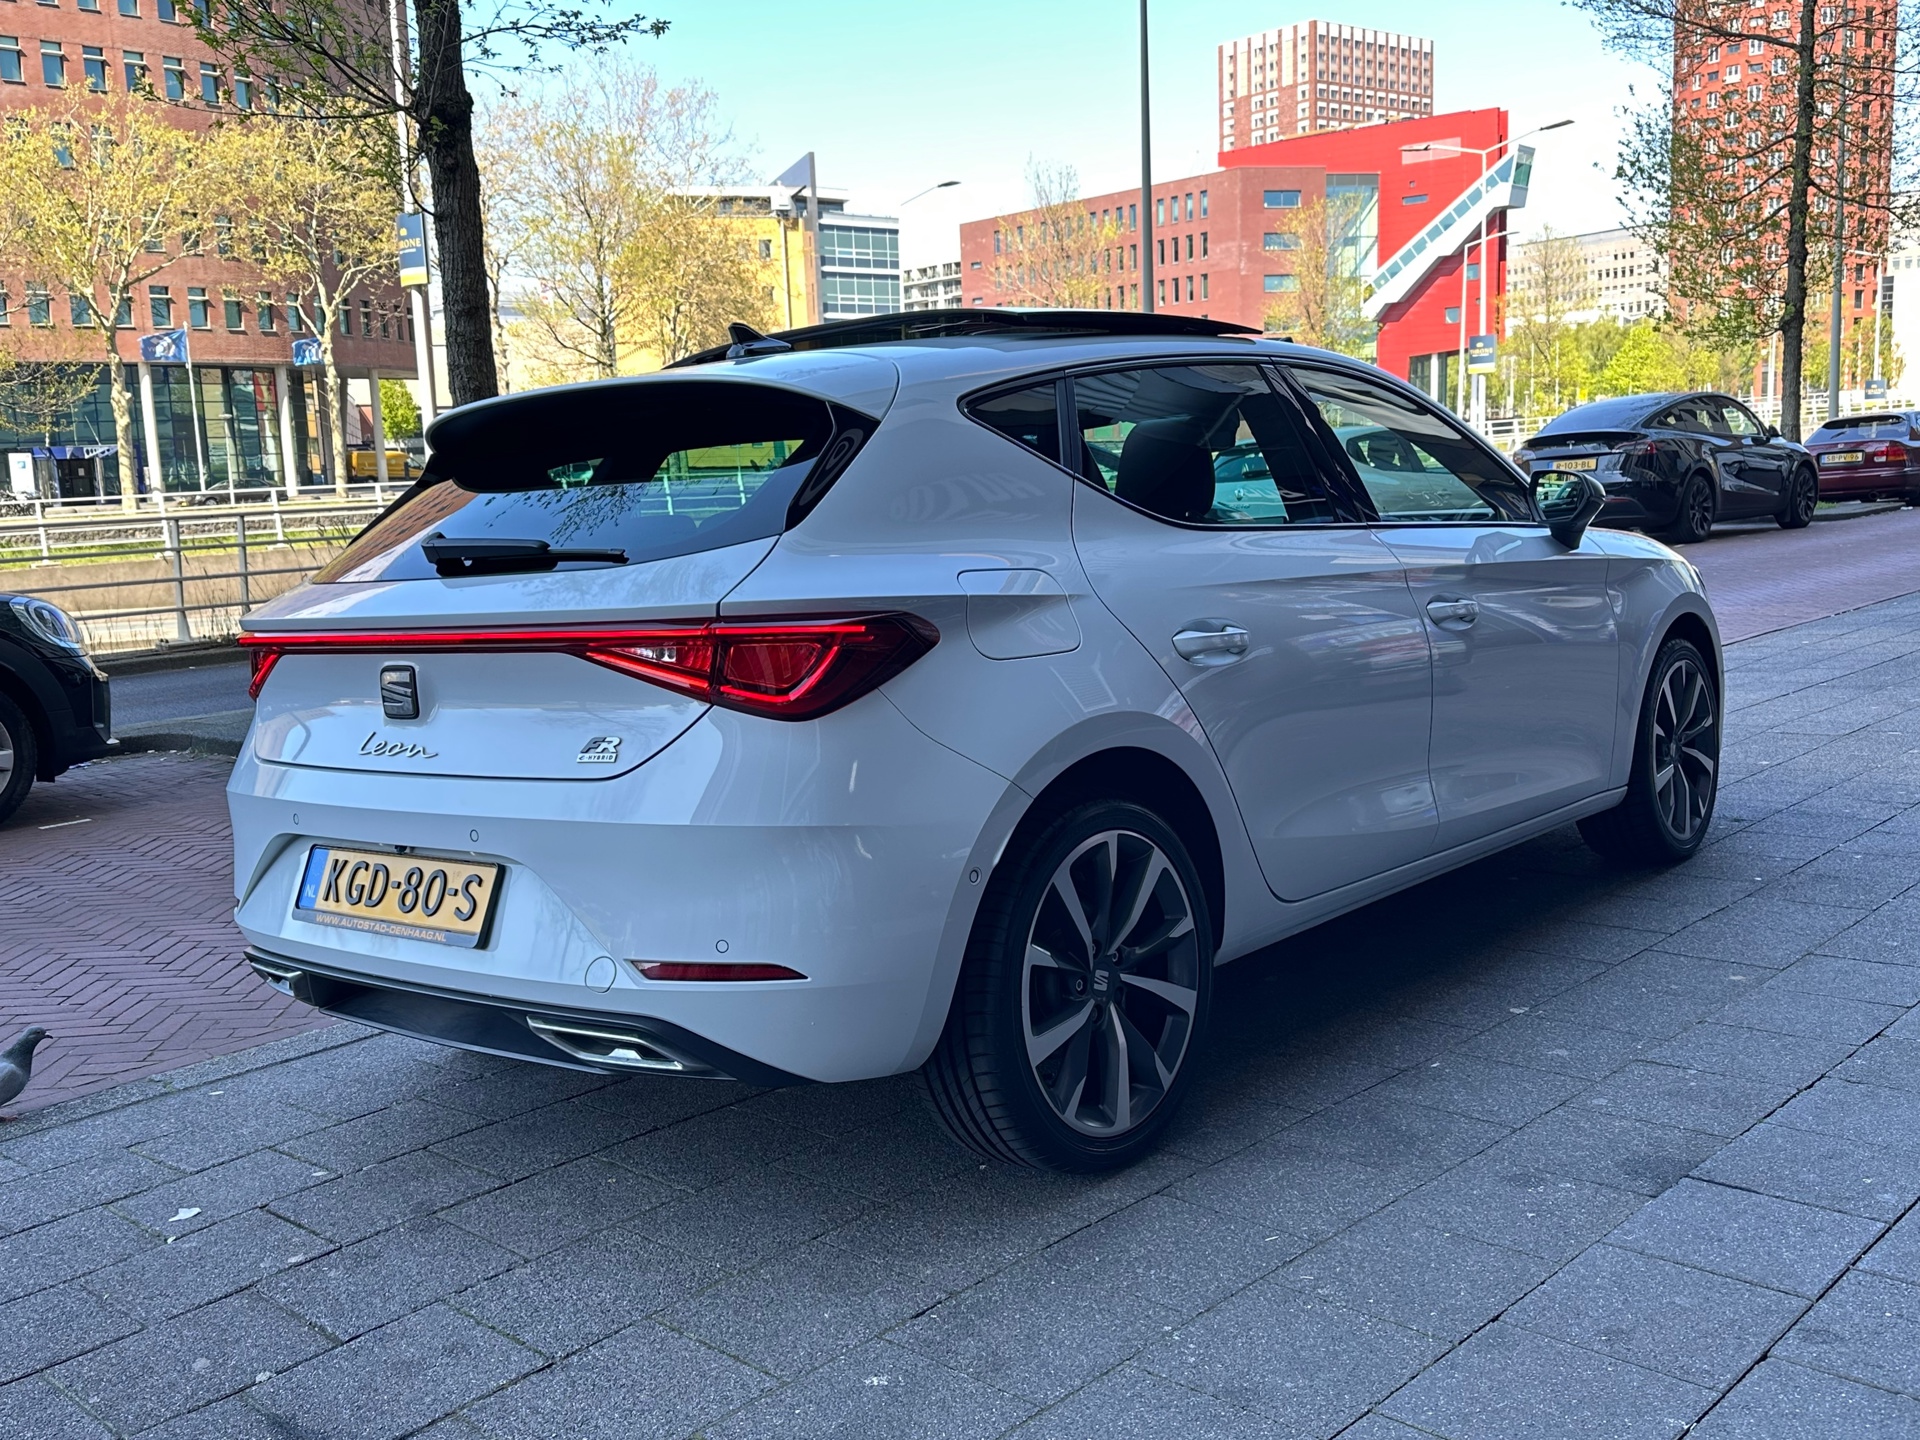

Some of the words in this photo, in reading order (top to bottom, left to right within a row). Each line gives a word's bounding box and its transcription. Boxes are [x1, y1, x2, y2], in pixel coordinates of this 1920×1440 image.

[1555, 460, 1592, 470] R-103-BL
[358, 731, 439, 759] Leon
[580, 736, 622, 753] FR
[304, 884, 316, 898] NL
[322, 858, 483, 922] KGD-80-S
[316, 913, 447, 942] WWW.AUTOSTAD-DENHAAG.NL
